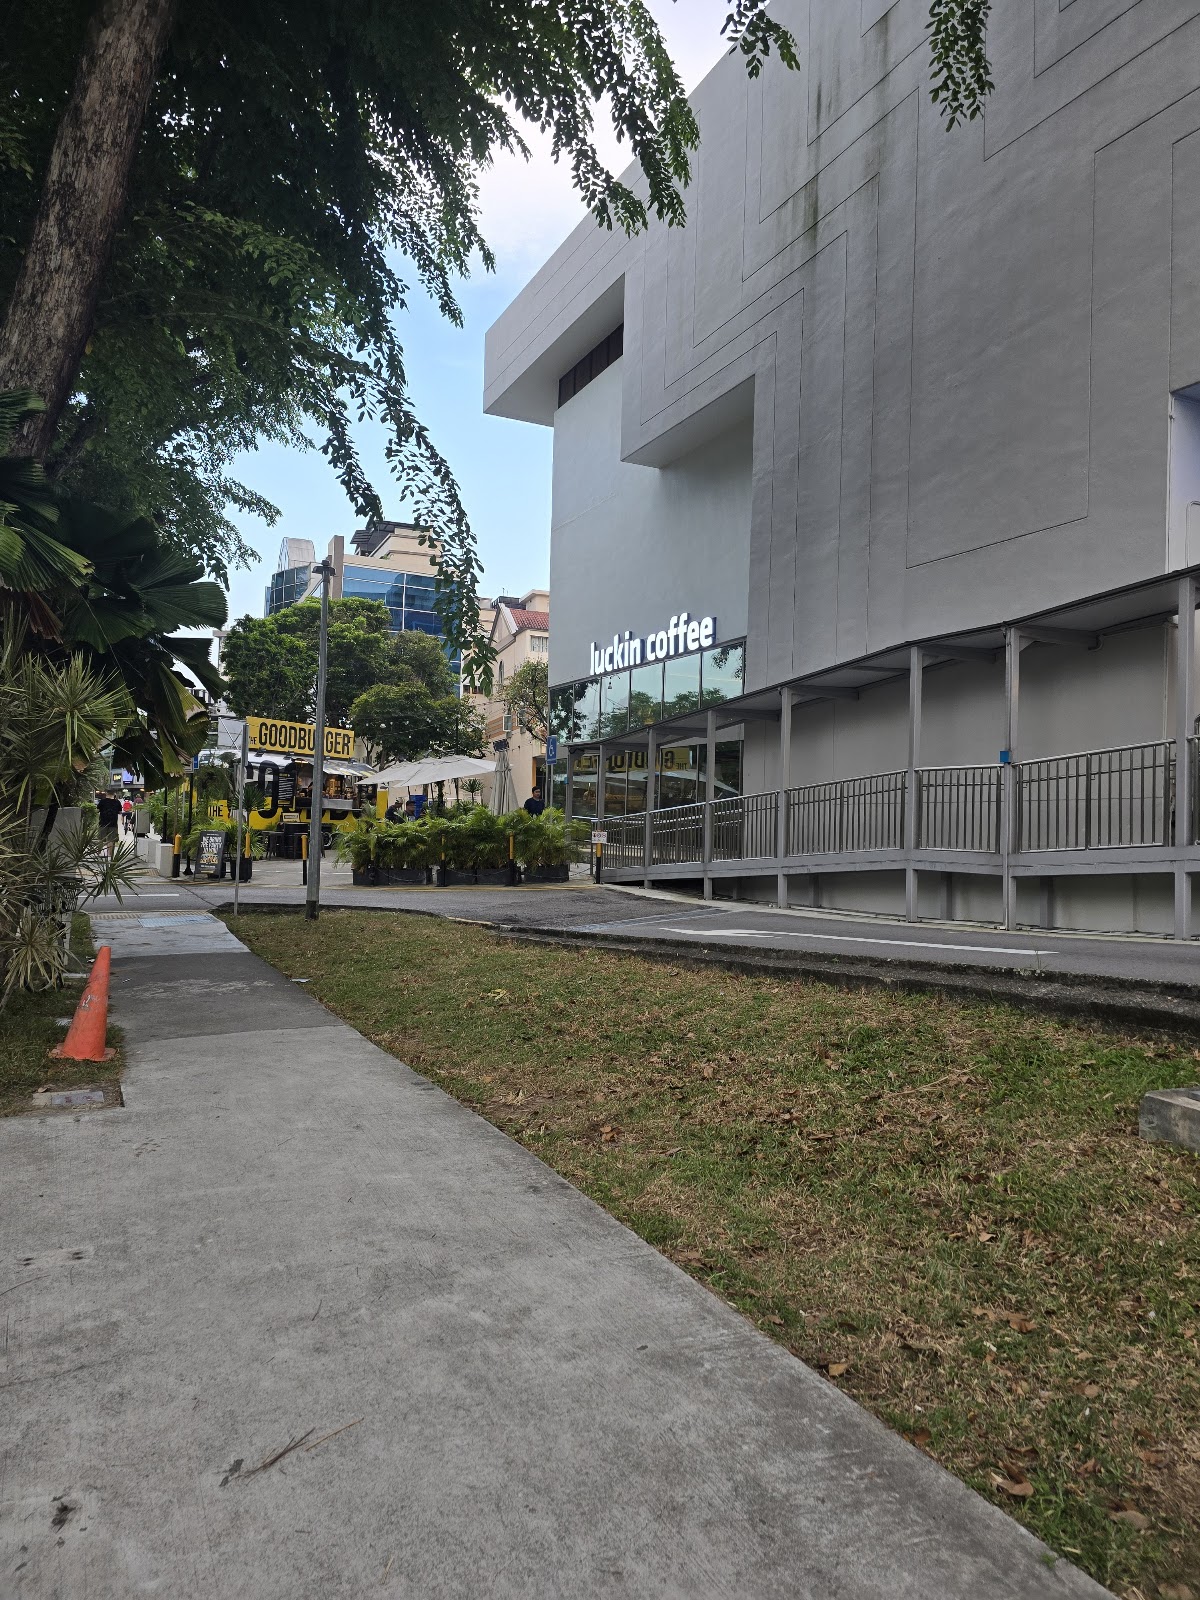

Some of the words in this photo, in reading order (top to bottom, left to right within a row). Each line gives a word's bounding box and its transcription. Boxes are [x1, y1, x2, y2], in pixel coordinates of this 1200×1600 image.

[589, 630, 643, 676] luckin
[646, 612, 715, 661] coffee
[259, 721, 350, 756] GOODBUGER
